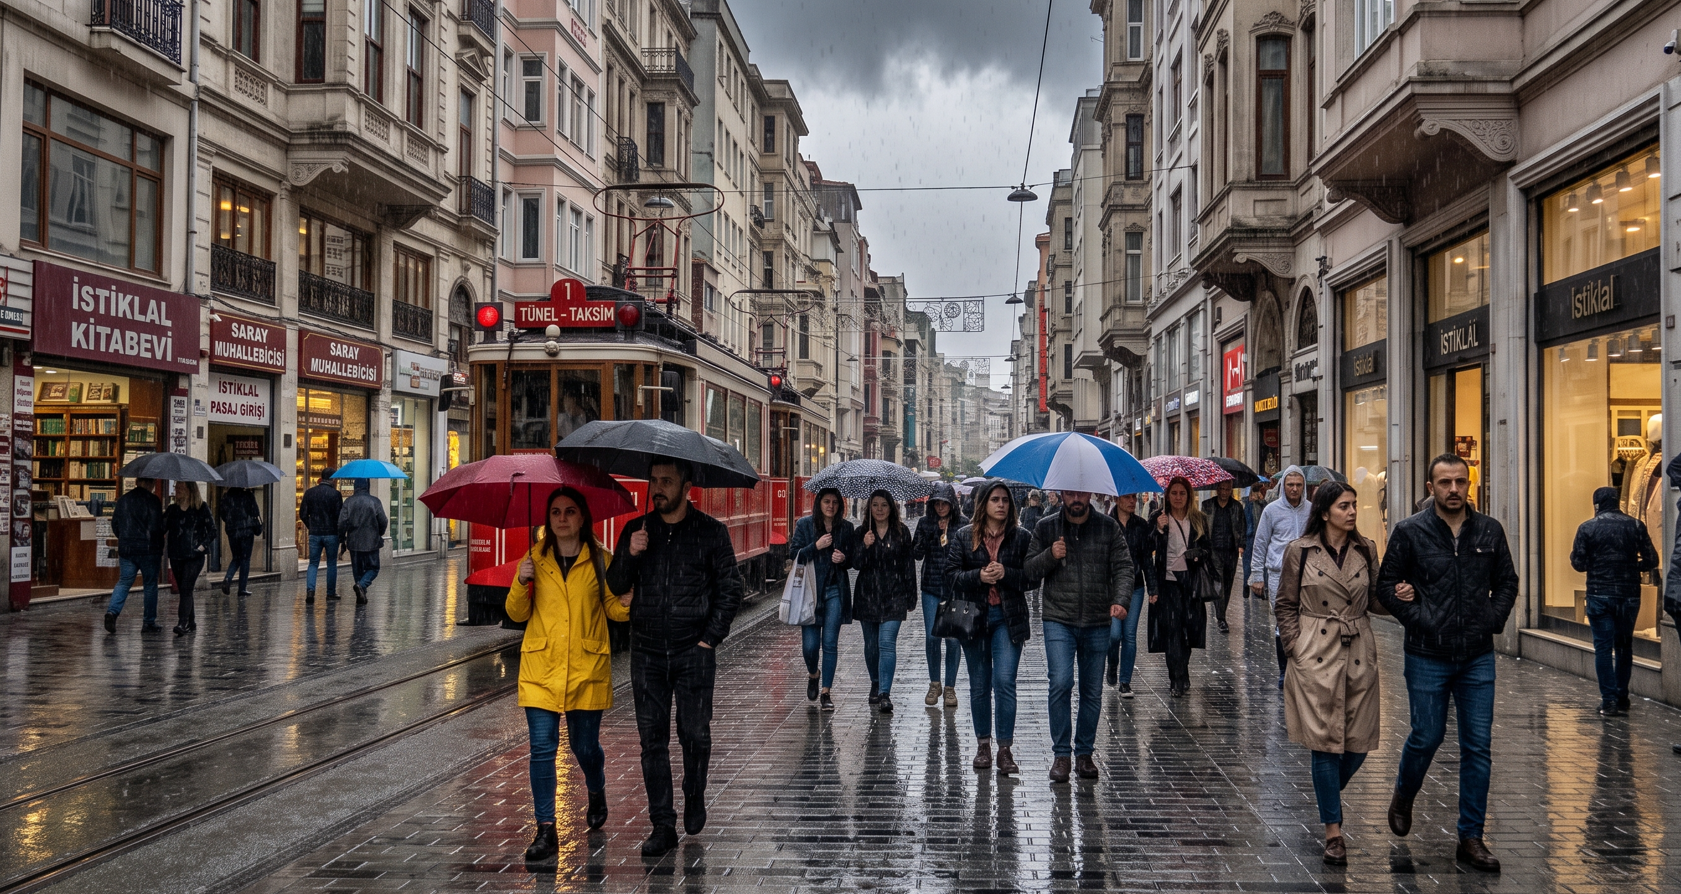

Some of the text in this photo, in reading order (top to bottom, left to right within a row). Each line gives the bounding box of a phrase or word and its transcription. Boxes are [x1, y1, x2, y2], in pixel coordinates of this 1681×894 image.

[73, 276, 172, 327] İSTİKLAL
[564, 282, 571, 300] 1
[519, 305, 558, 322] TÜNEL
[569, 303, 614, 322] TAKSİM
[71, 317, 172, 362] KİTABEVİ
[231, 322, 269, 344] SARAY
[214, 340, 285, 367] MUHALLEBİCİSİ
[330, 342, 360, 360] SARAY
[311, 358, 377, 382] MUHALLEBİCİSİ
[218, 377, 260, 397] İSTİKLAL
[210, 400, 238, 417] PASAJ
[240, 401, 266, 421] GİRİŞİ
